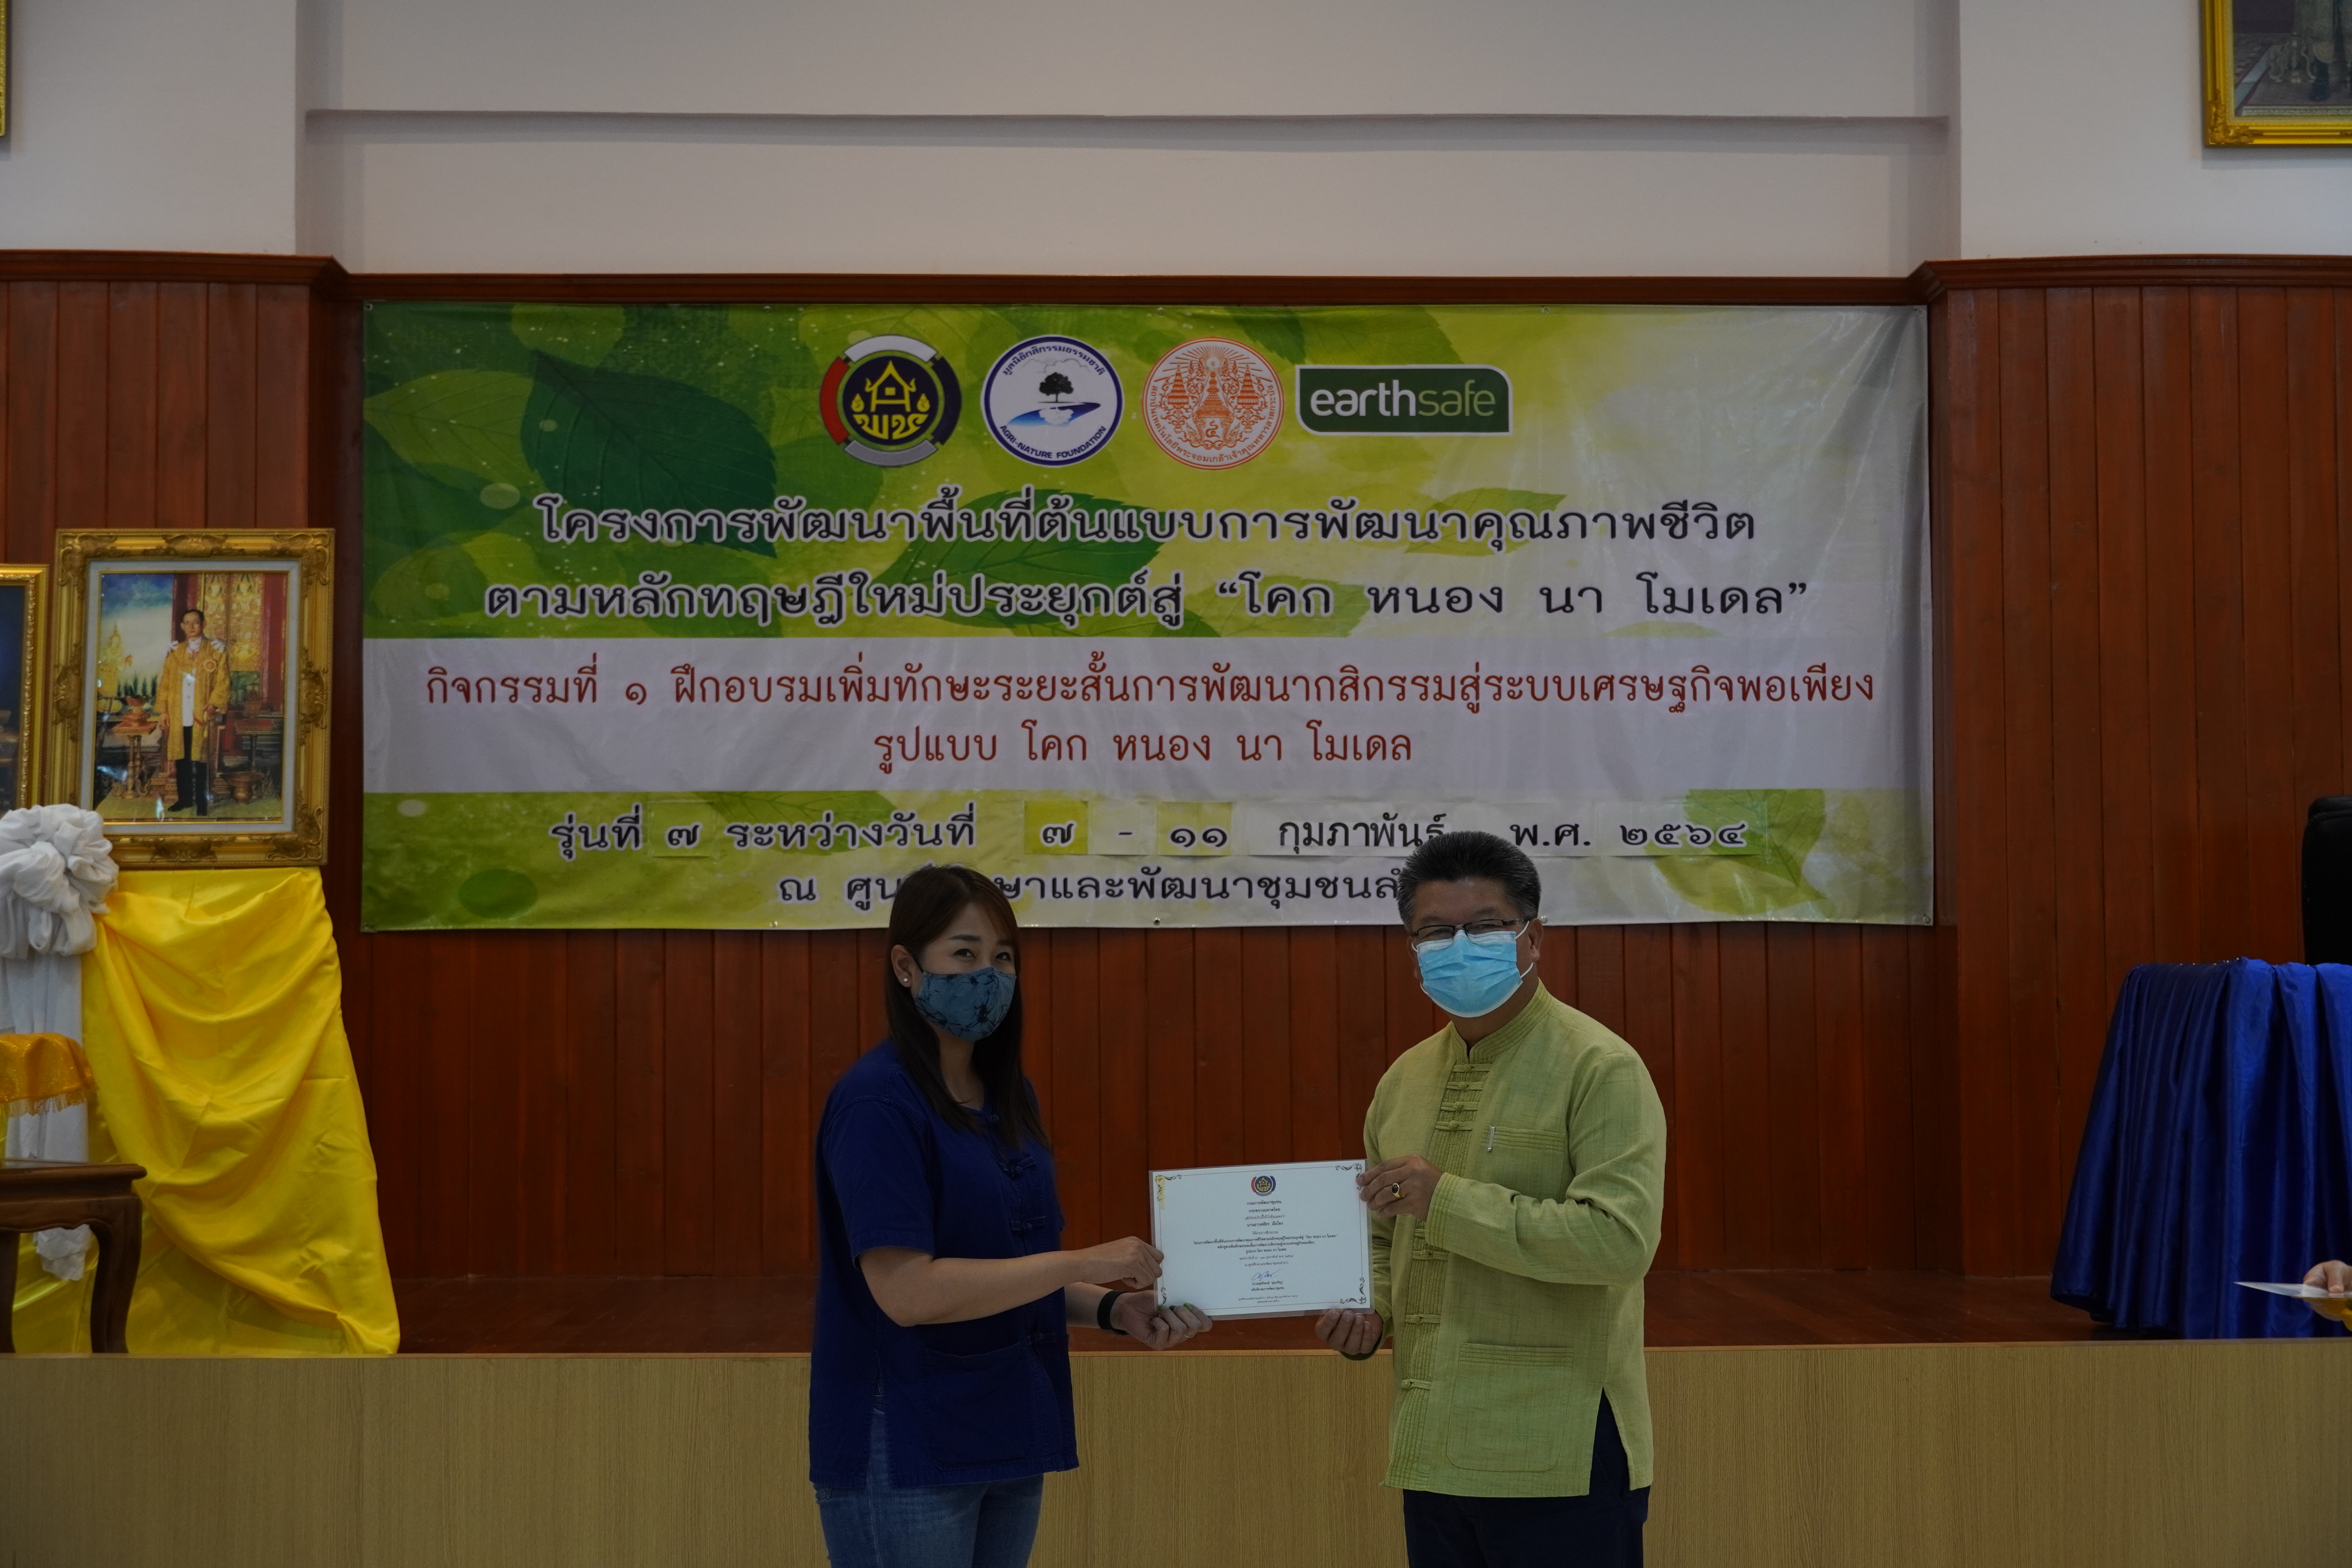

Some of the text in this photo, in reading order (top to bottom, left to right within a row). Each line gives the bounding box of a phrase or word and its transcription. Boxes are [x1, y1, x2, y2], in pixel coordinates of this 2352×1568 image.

[1002, 346, 1106, 376] มูลนิธิกสิกรรมธรรมชาติ
[1310, 379, 1496, 417] earthsafe
[1000, 425, 1107, 459] AGRI-NATURE FOUNDATION
[535, 485, 1755, 553] โครงการพัฒนาพื้นที่ต้นแบบการพัฒนาคุณภาพชีวิต
[487, 569, 1181, 628] ตามหลักทฤษฎีใหม่ประยุกต์สู่
[1367, 586, 1503, 614] หนอง
[1539, 586, 1602, 614] นา
[426, 652, 597, 705] กิจกรรมที่
[671, 651, 1874, 713] ฝึกอบรมเพิ่มทักษะระยะสั้นการพัฒนากสิกรรมสู่ระบบเศรษฐกิจพอเพียง
[874, 718, 1413, 775] รูปแบบ โคก หนอง นา โมเดล
[551, 804, 640, 859] รุ่นที่
[667, 824, 699, 847] ๗
[726, 802, 974, 848] ระหว่างวันที่
[1042, 822, 1074, 844] ๗
[1170, 826, 1227, 848] ๑๑
[1509, 821, 1591, 848] พ.ศ.
[1619, 820, 1749, 849] ๒๕๖๔
[779, 878, 816, 901] ณ
